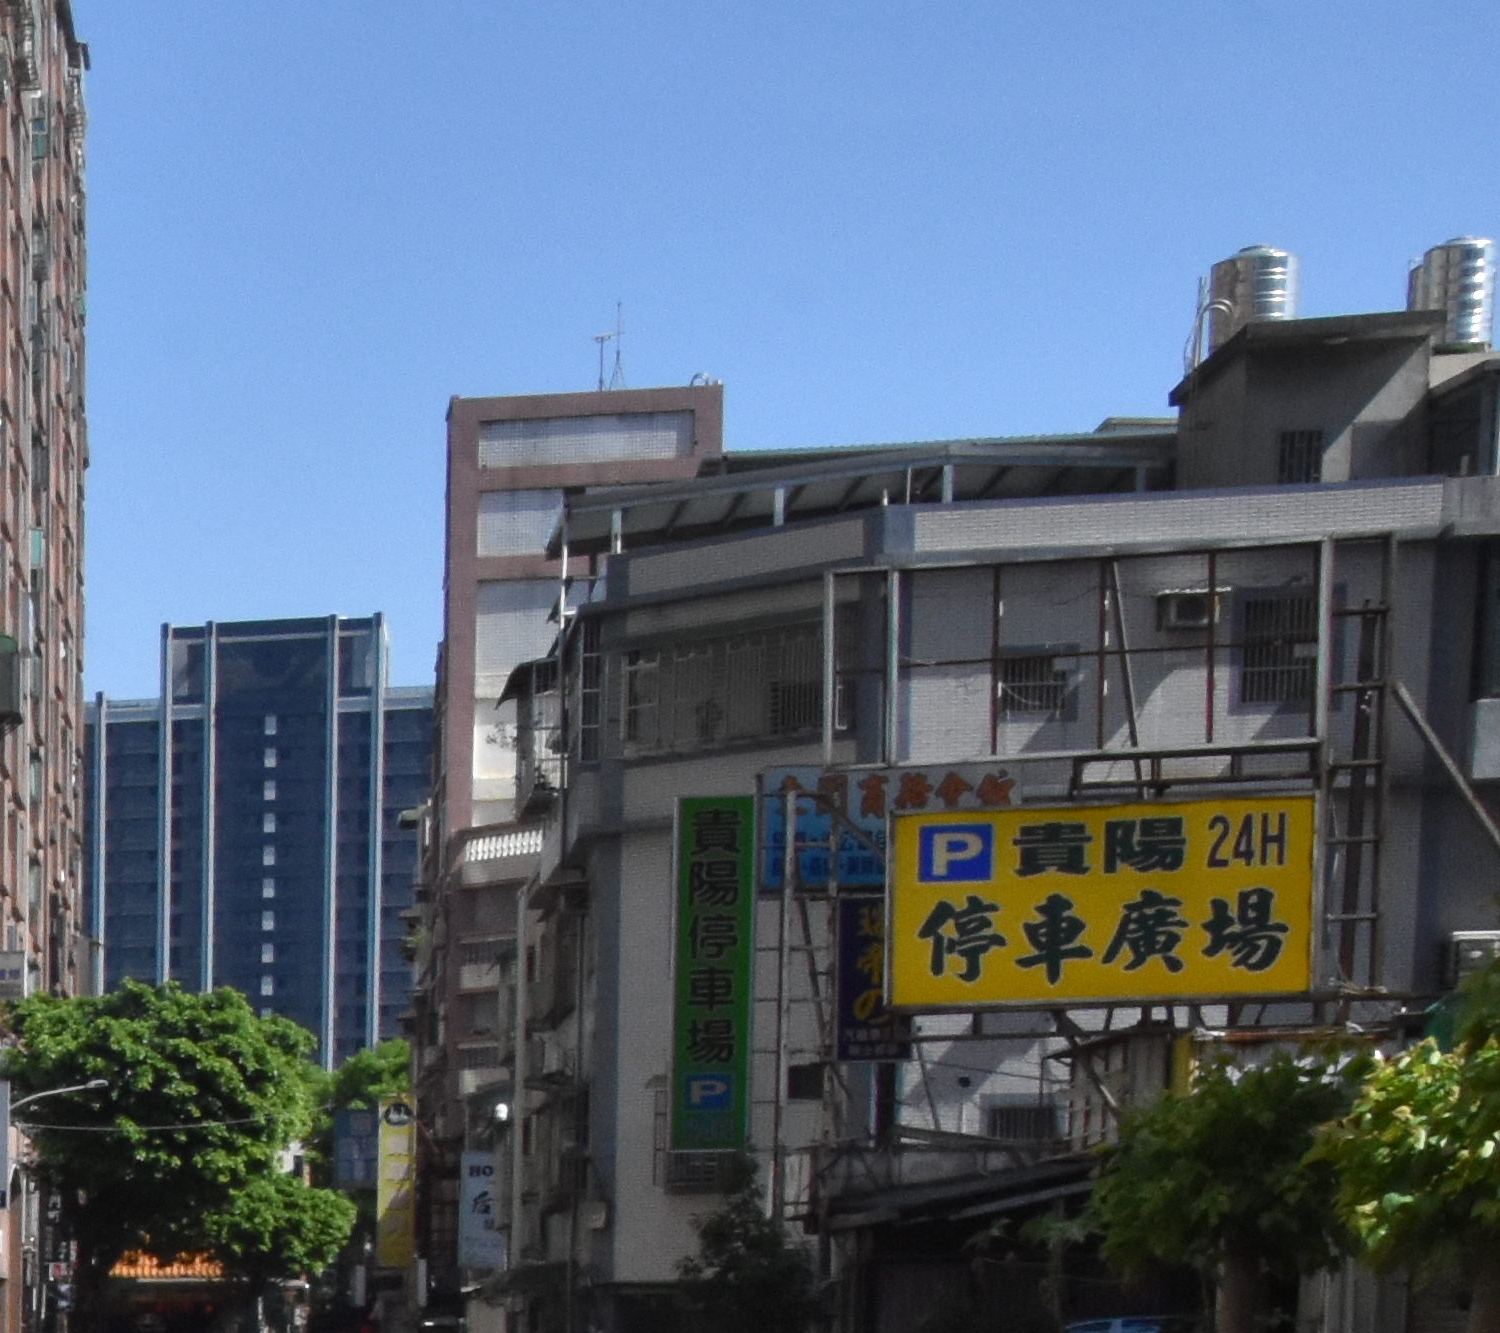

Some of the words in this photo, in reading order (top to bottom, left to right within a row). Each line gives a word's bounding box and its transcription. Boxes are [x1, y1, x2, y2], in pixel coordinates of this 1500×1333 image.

[1012, 815, 1188, 877] 貴陽
[1207, 811, 1287, 869] 24H
[686, 807, 743, 1065] 貴陽停車場
[917, 887, 1290, 987] 停車廣場
